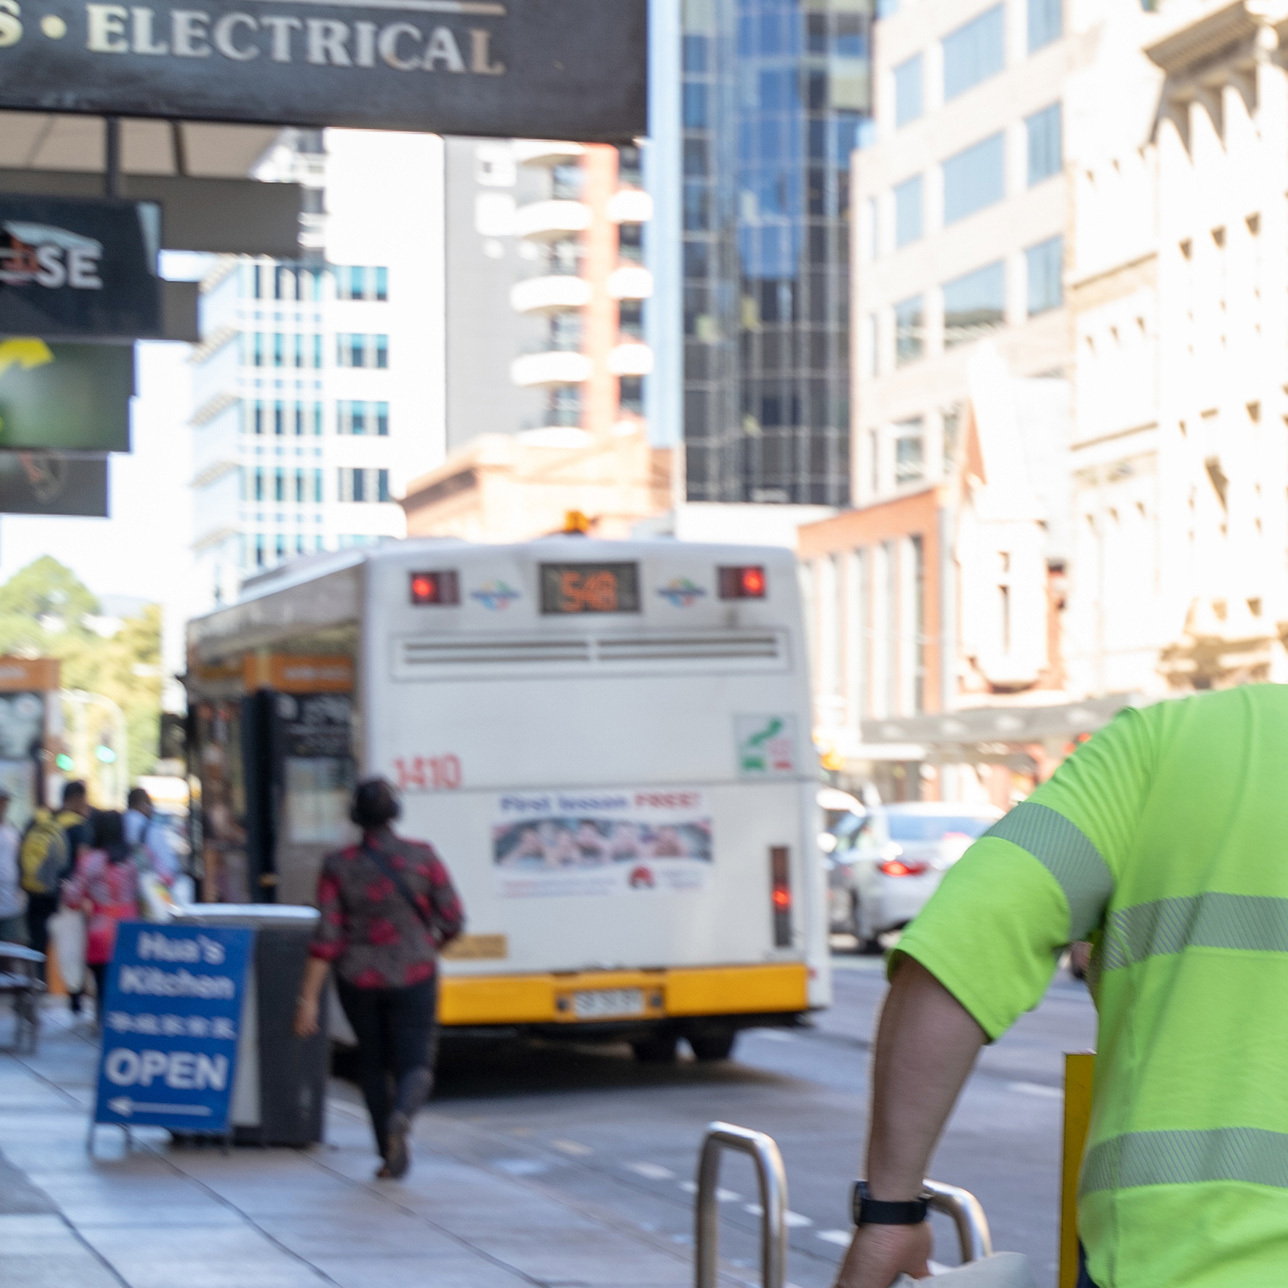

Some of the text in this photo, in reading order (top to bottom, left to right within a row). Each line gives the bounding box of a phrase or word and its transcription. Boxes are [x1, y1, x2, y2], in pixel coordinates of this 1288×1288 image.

[86, 3, 506, 75] ELECTRICAL
[393, 754, 462, 790] 1410
[501, 795, 550, 811] First
[137, 930, 226, 965] Hua's
[117, 965, 235, 999] Kitchen
[105, 1048, 228, 1092] OPEN
